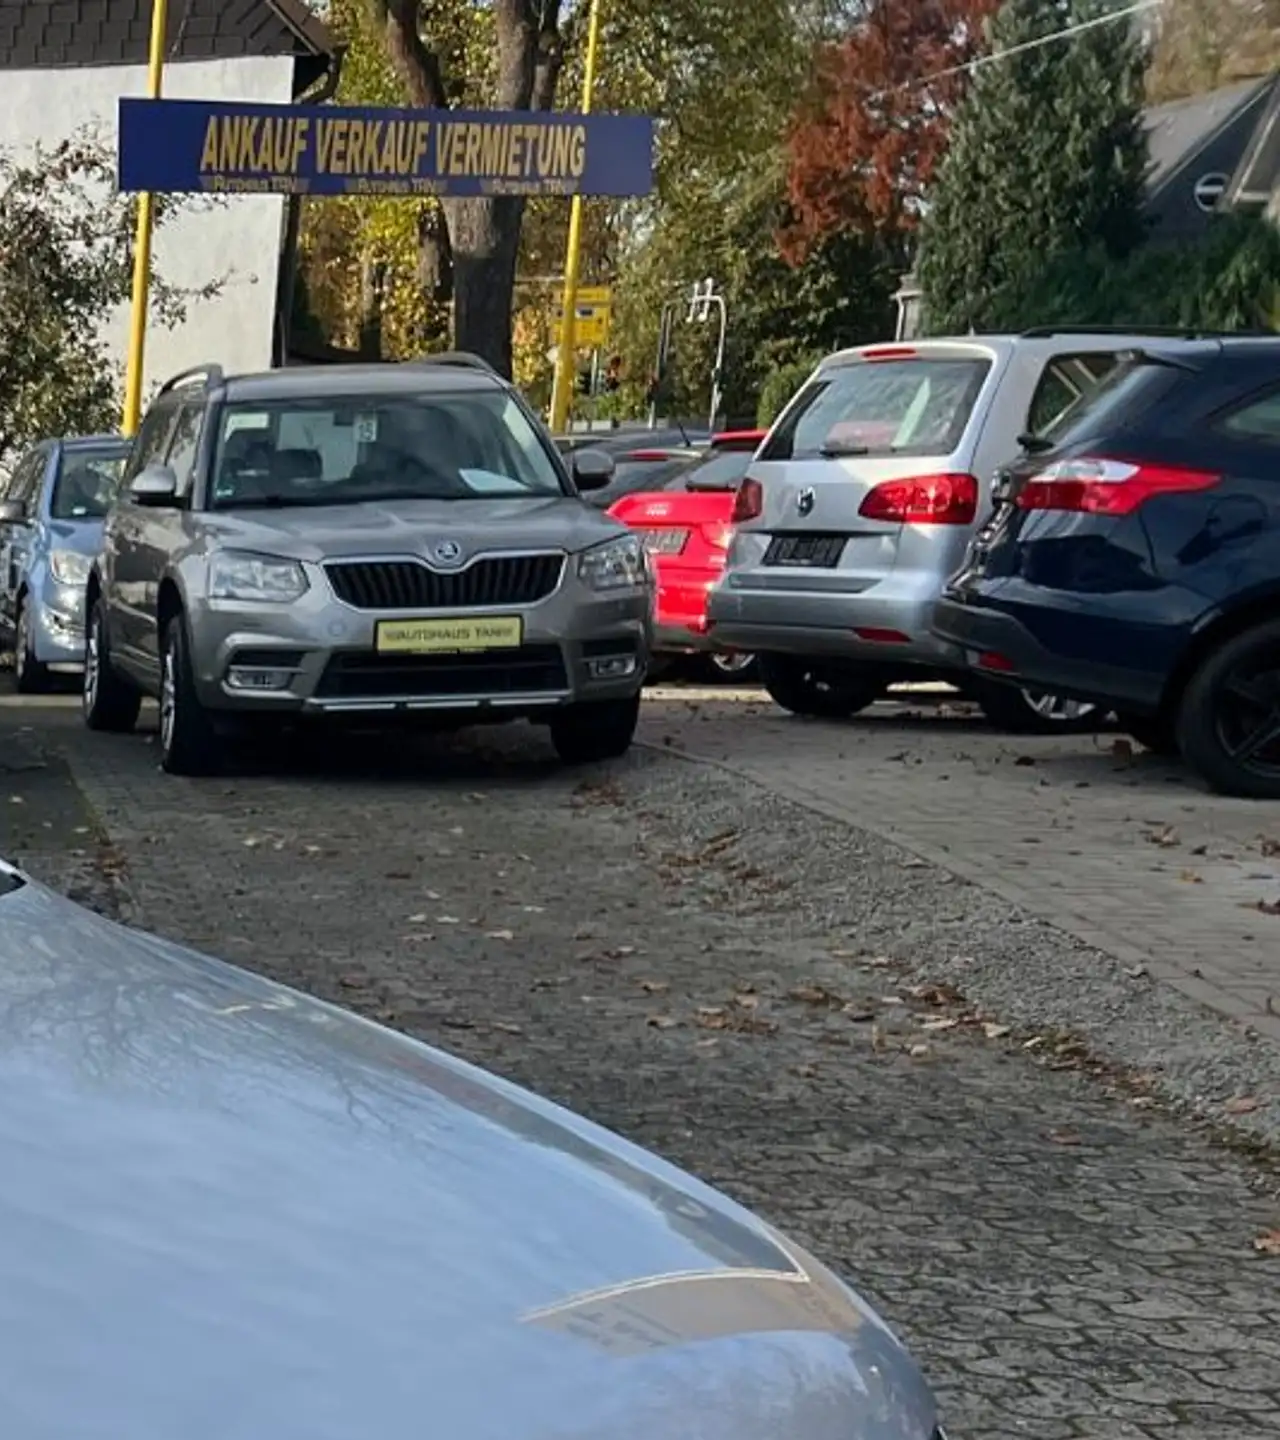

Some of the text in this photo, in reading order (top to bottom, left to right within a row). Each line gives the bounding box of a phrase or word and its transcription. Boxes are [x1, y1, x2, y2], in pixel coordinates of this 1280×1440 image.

[200, 115, 586, 177] ANKAUF VERKAUF VERMIETUNG
